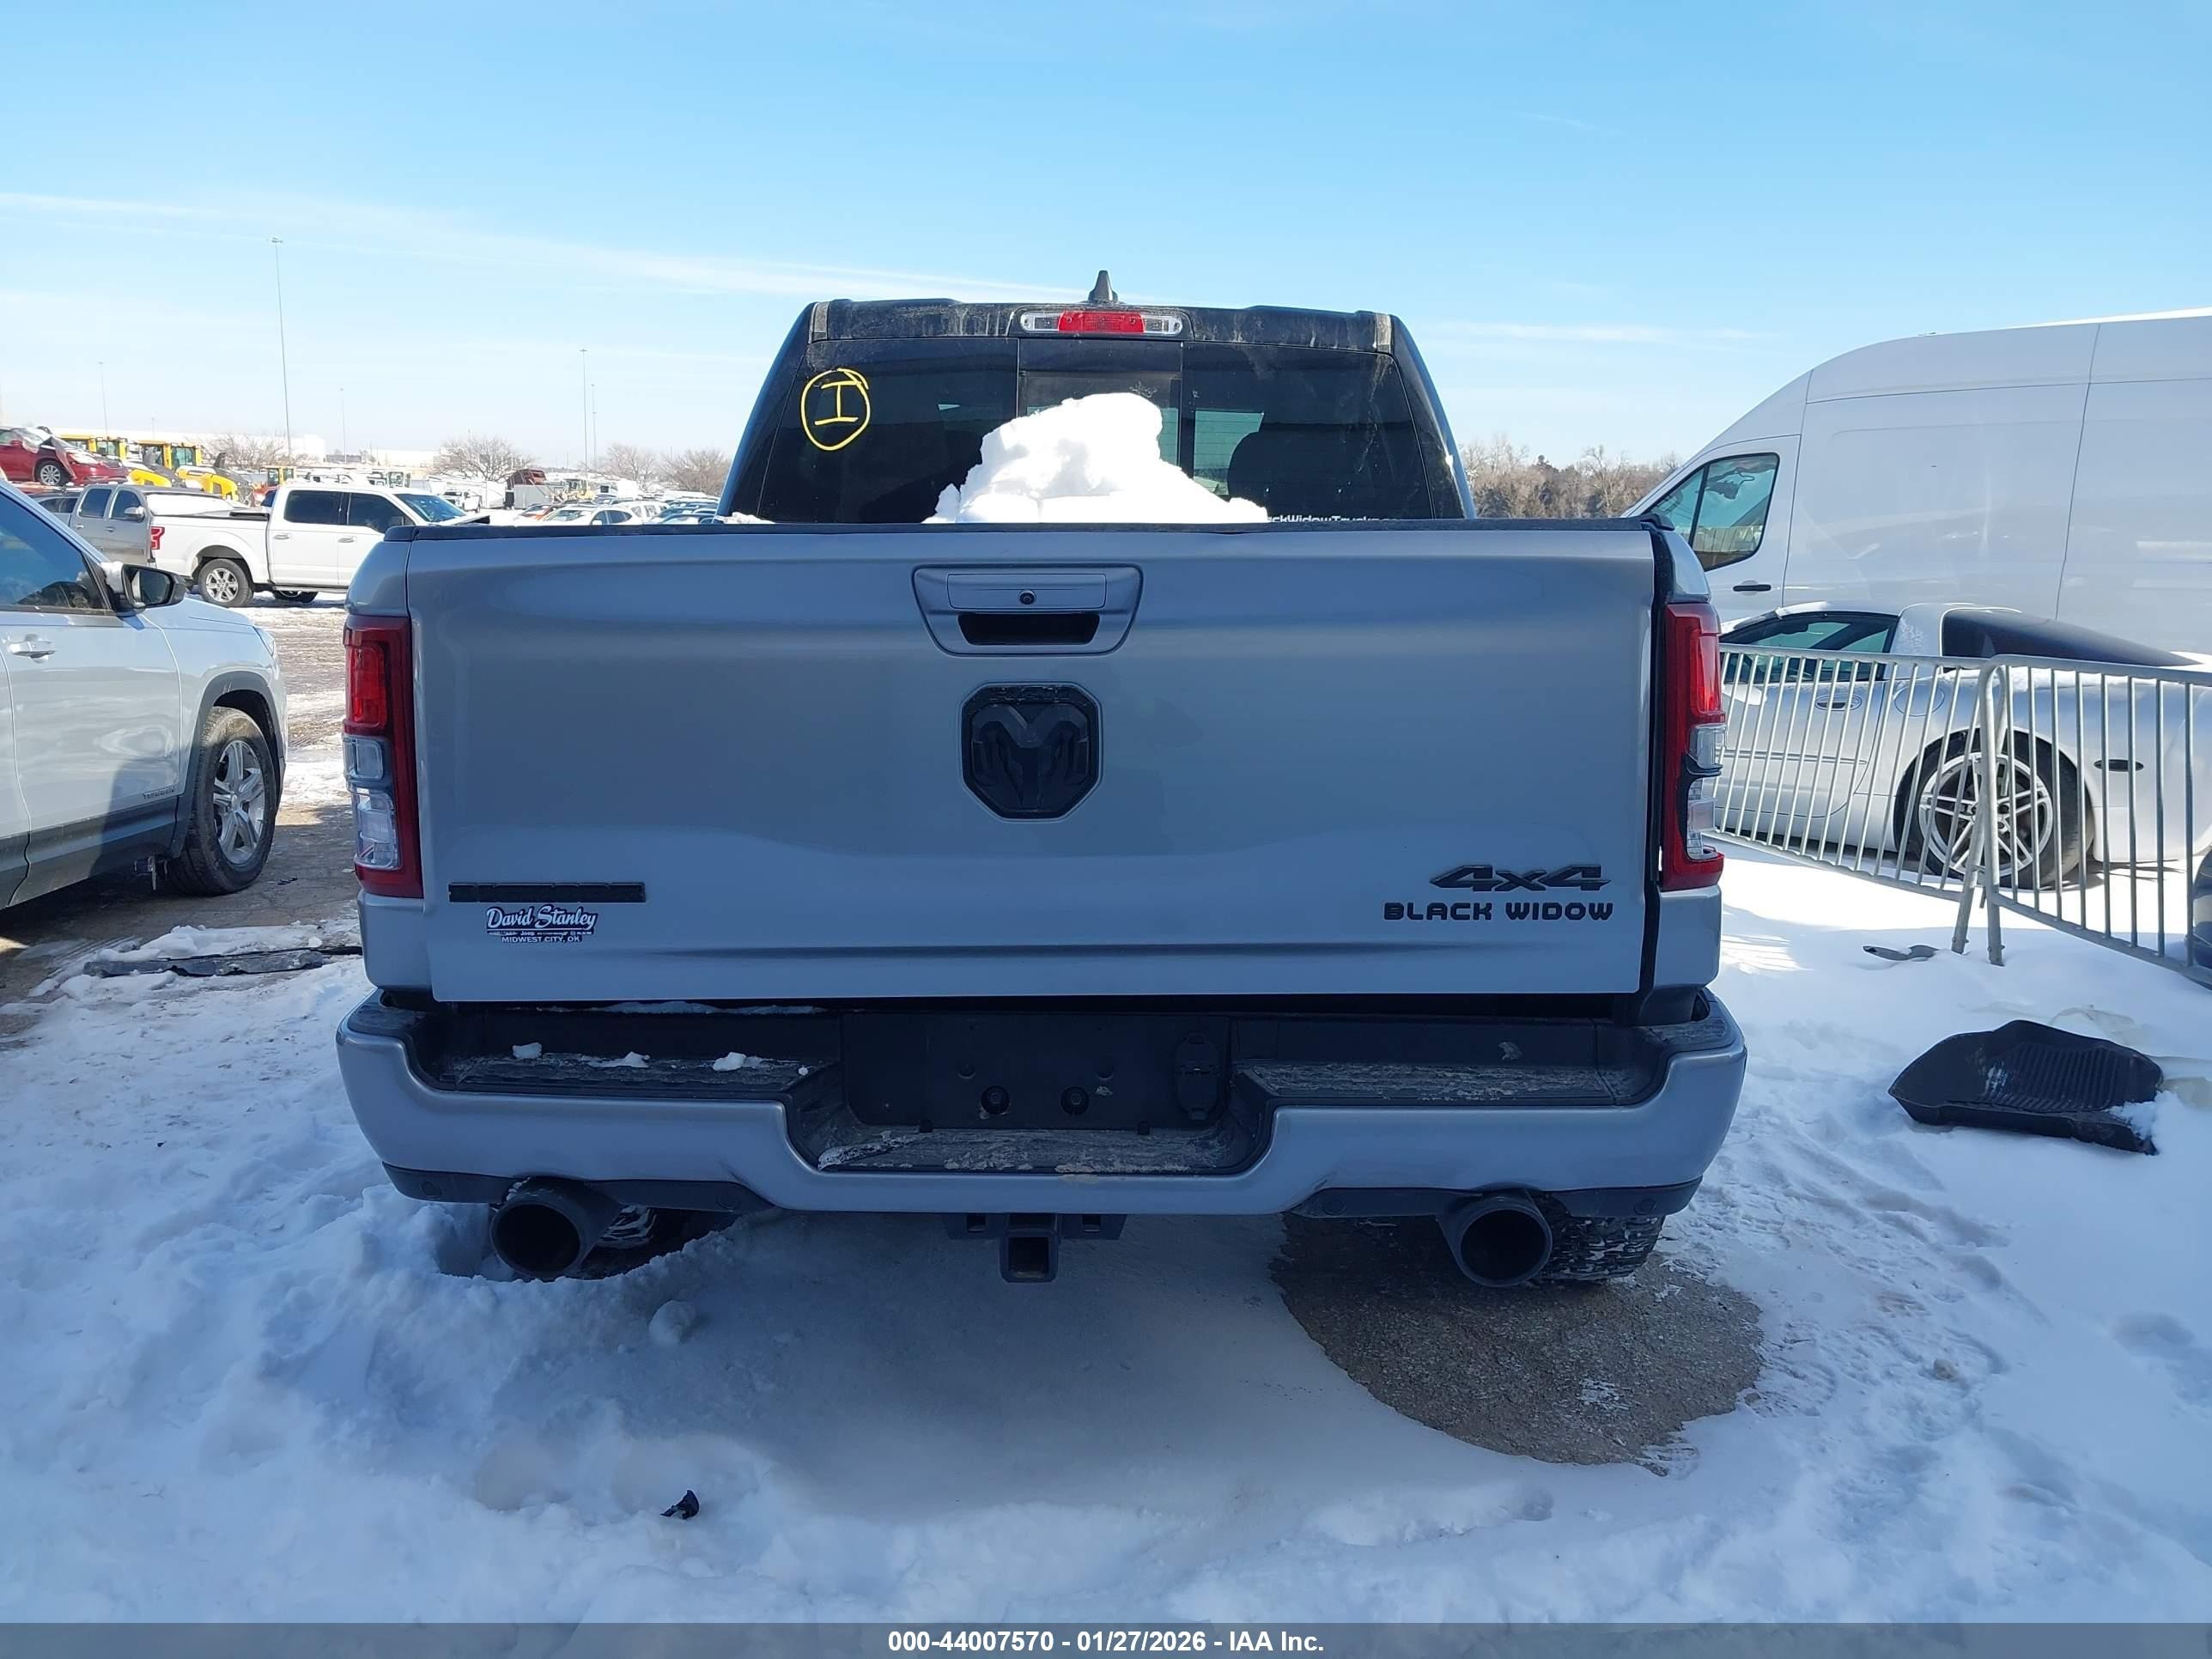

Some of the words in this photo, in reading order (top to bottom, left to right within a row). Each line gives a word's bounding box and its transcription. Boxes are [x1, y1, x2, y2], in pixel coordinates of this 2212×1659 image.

[1428, 864, 1612, 892] 4x4
[486, 906, 534, 928] David
[534, 904, 597, 931] Stanley
[1383, 902, 1492, 921] BLACK
[1505, 902, 1613, 921] WIDOW
